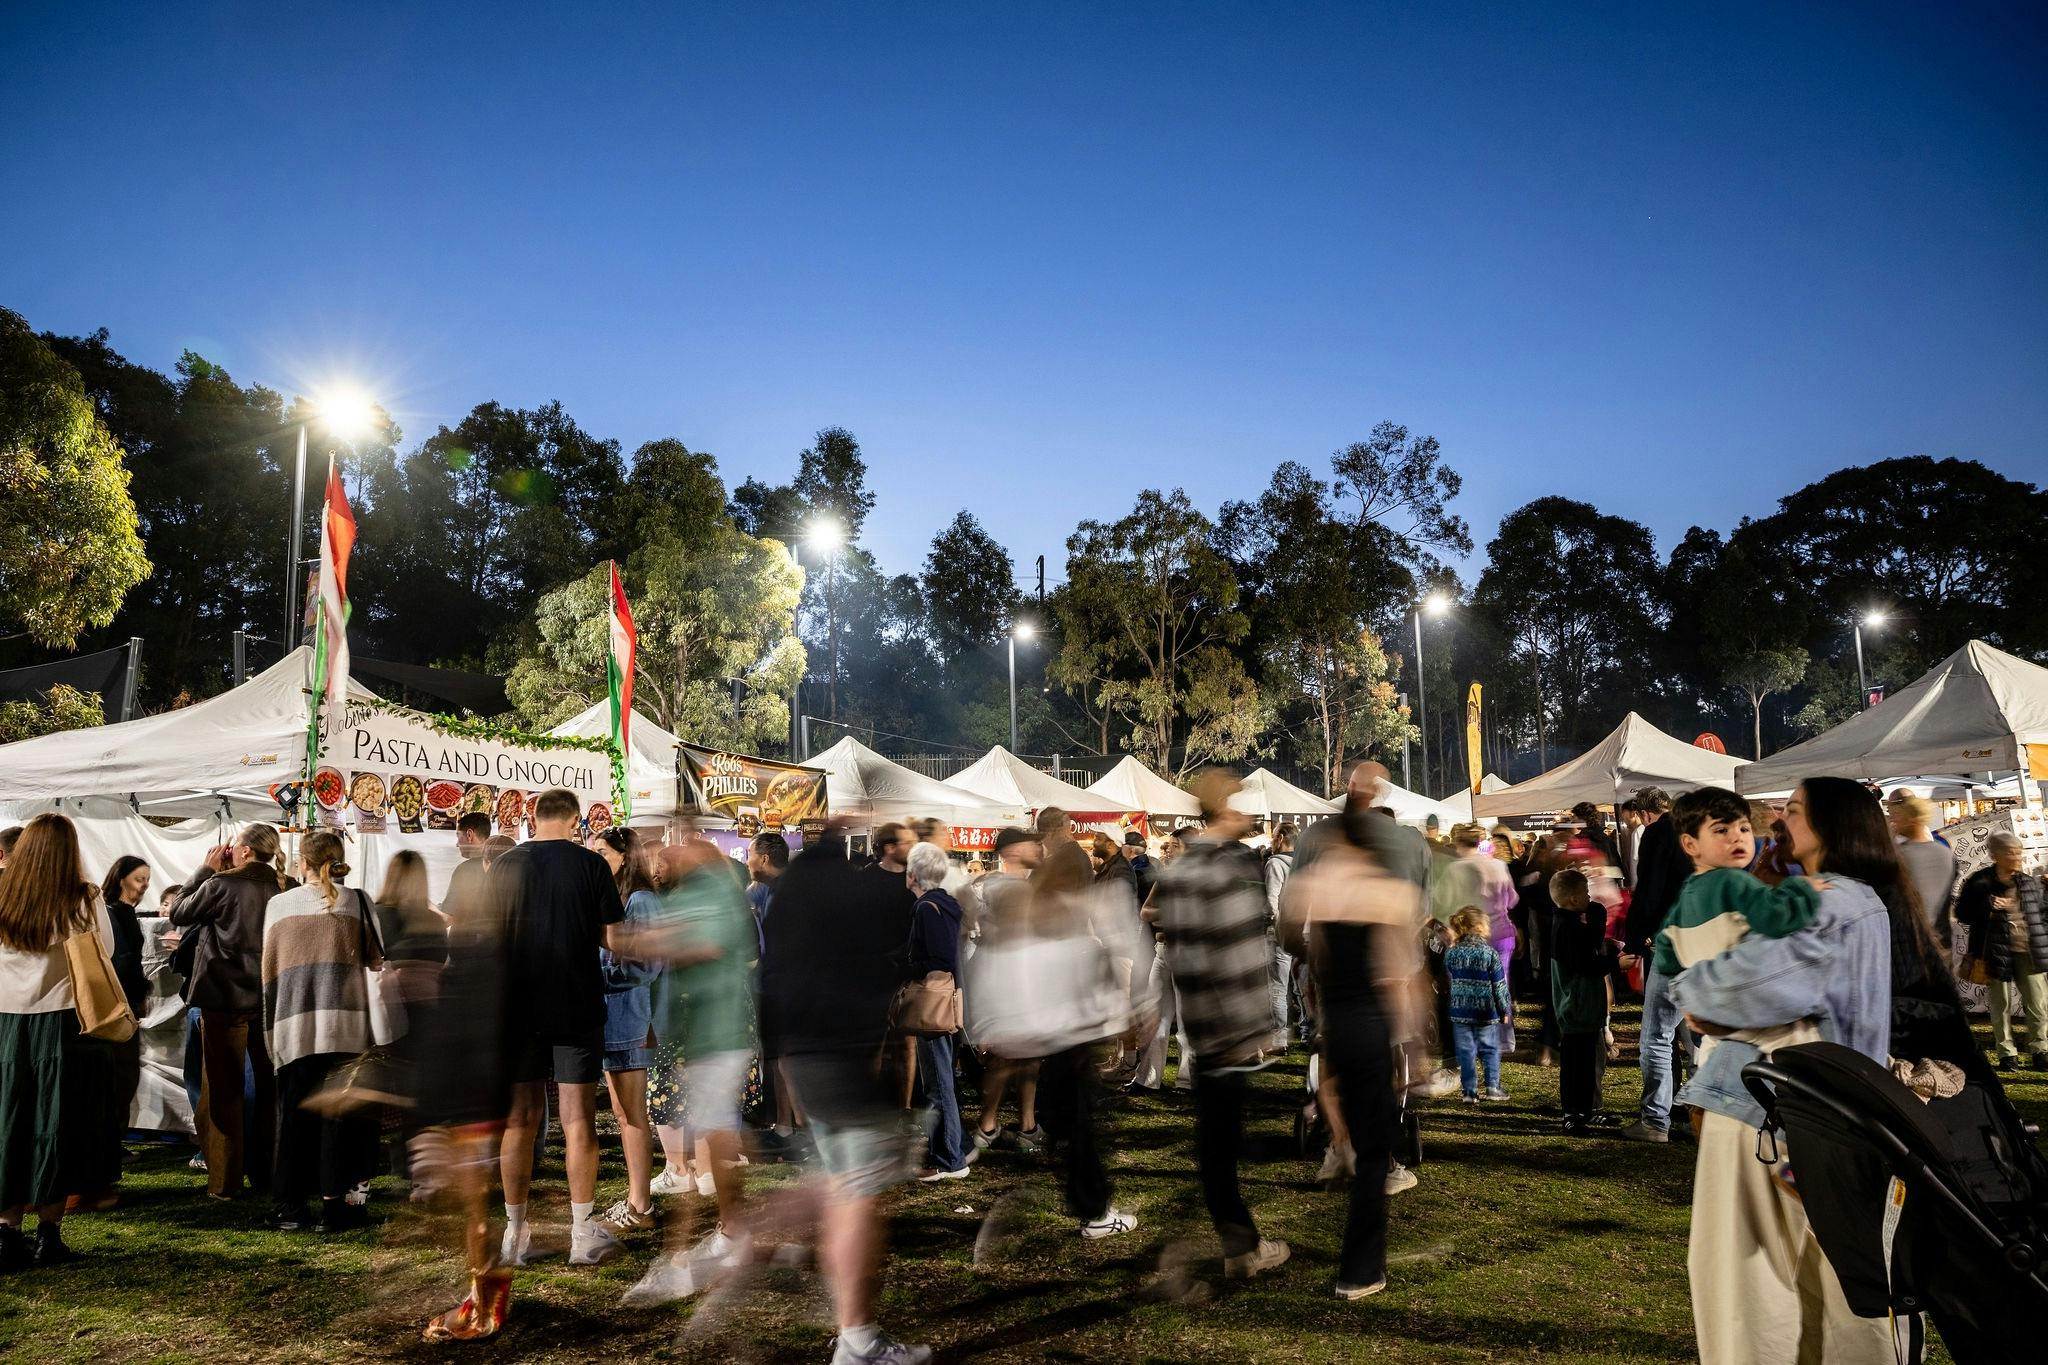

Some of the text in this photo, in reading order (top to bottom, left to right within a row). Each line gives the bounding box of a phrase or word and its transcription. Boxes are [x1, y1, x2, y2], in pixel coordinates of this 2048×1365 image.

[353, 729, 593, 789] PASTA AND GNOCCHI
[711, 752, 742, 775] Rob's
[702, 775, 758, 800] PHILLIES
[1969, 844, 1989, 858] Crep
